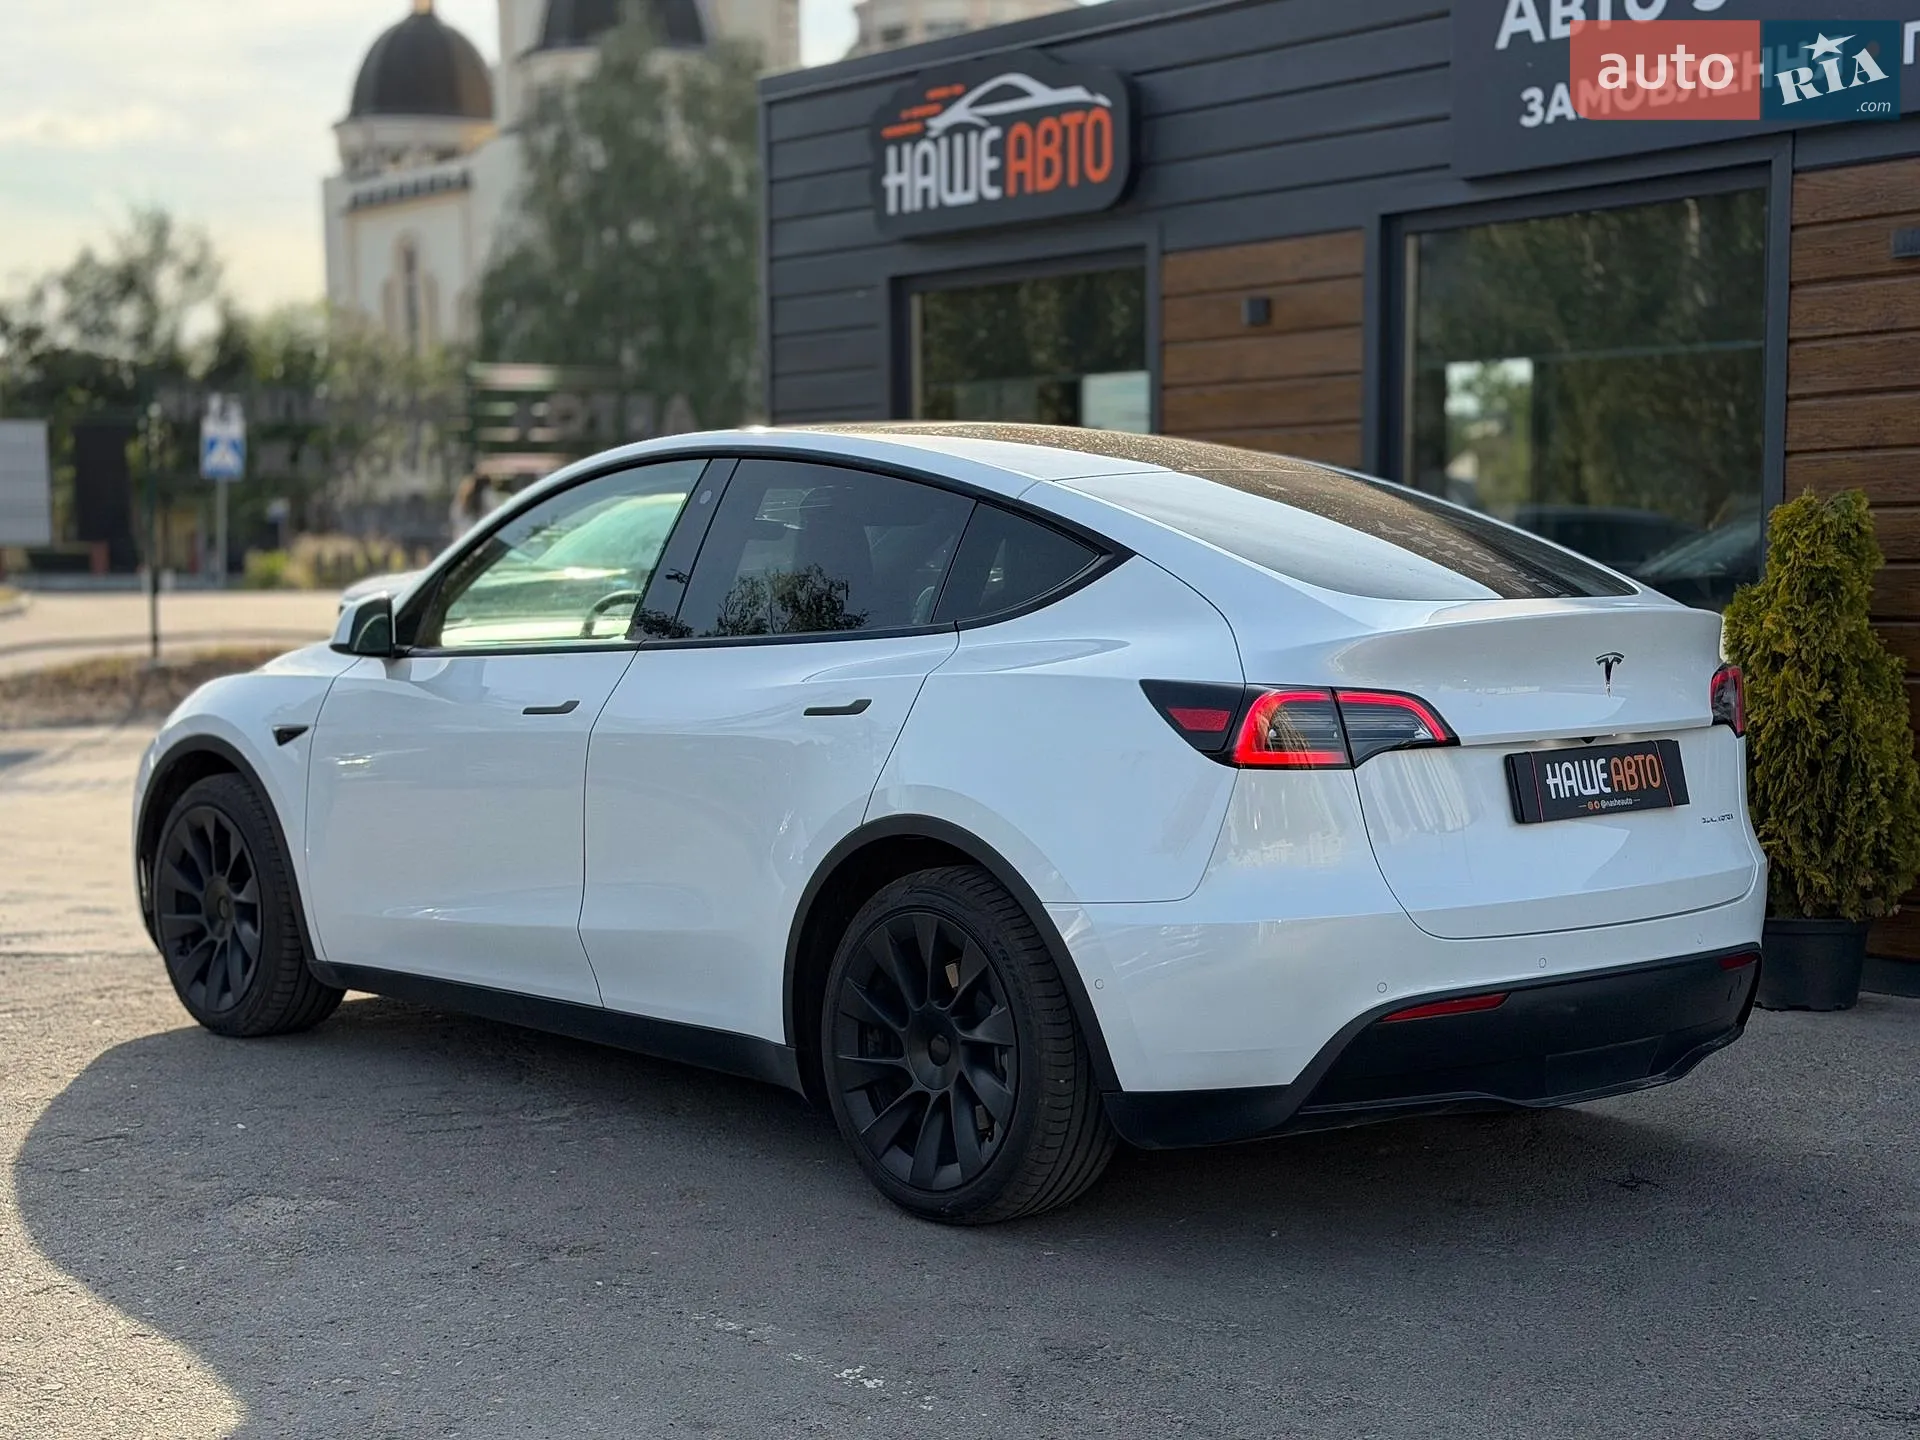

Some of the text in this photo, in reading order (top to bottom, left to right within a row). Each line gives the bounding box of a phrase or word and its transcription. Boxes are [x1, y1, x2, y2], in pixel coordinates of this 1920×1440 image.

[881, 106, 1114, 215] НАШЕ АВТО
[1546, 754, 1662, 799] НАШЕ АВТО
